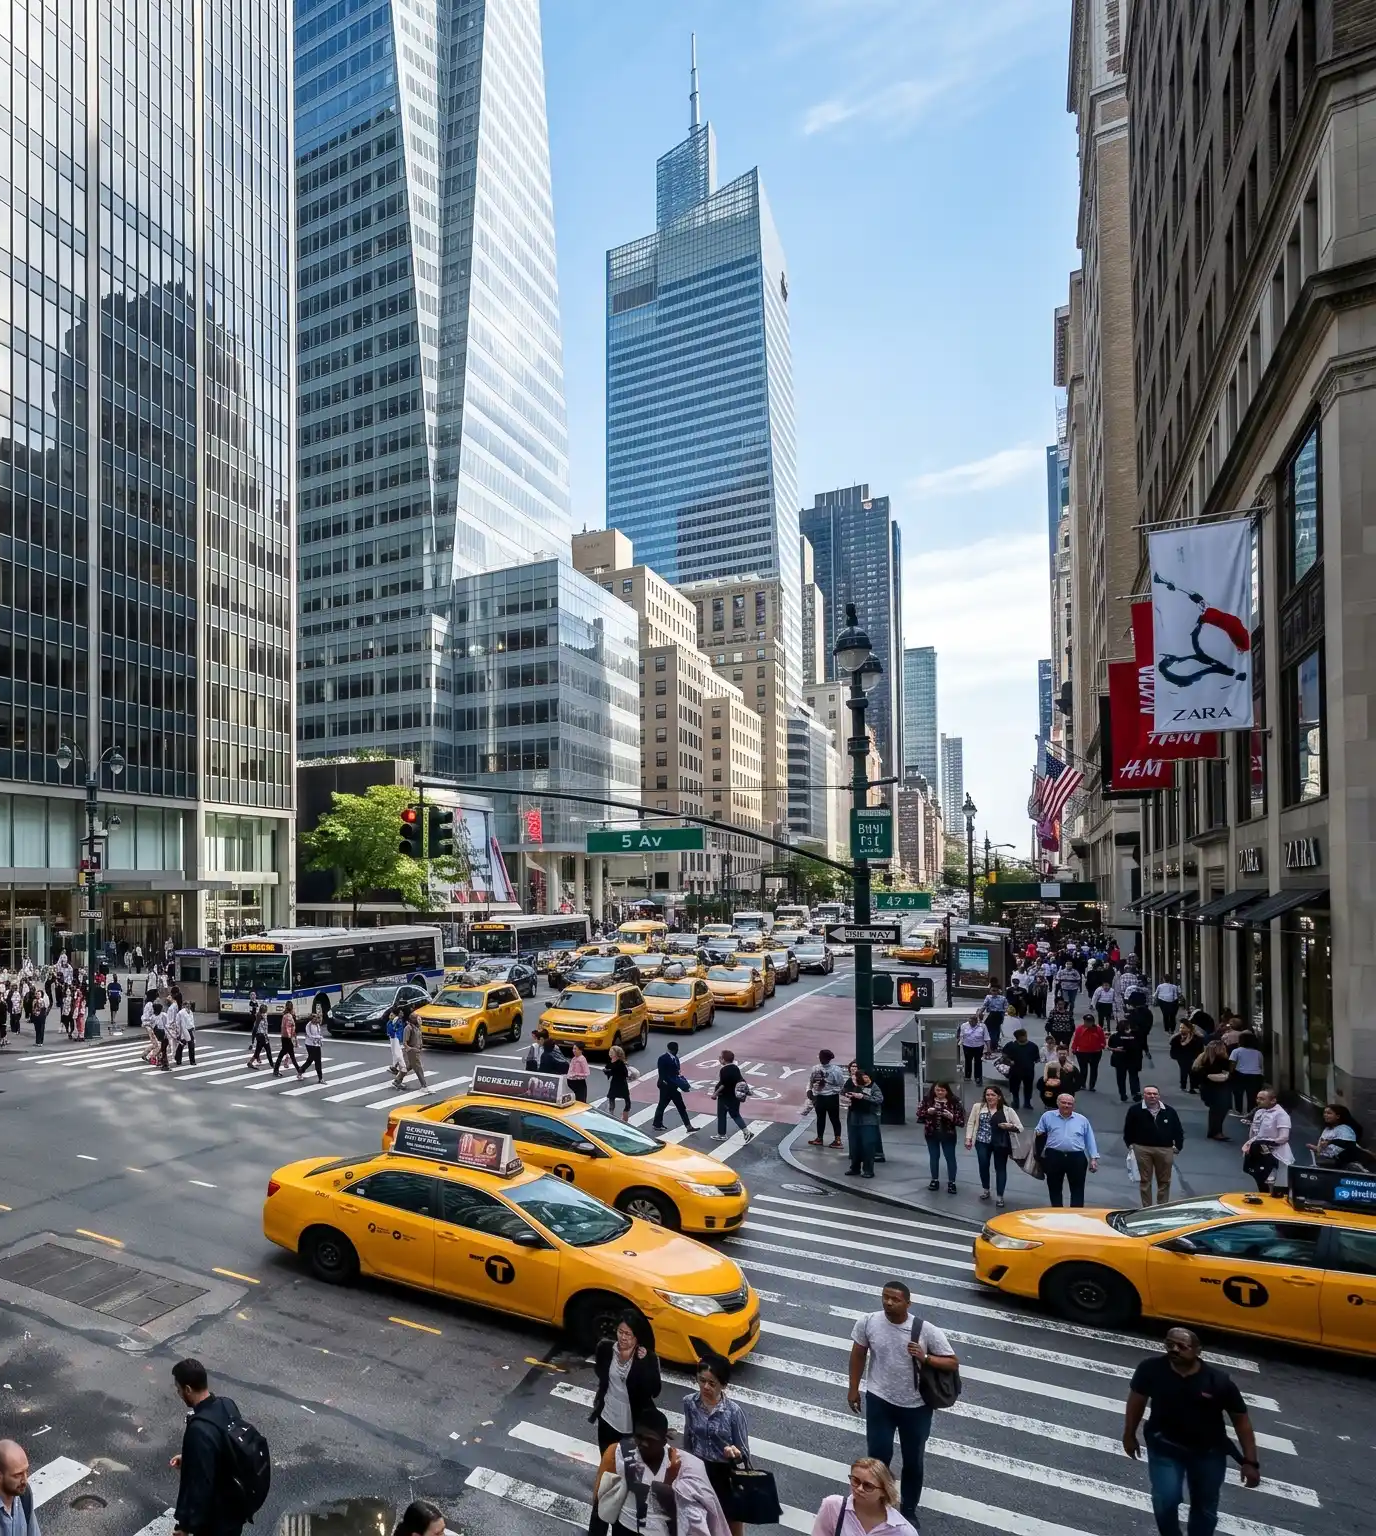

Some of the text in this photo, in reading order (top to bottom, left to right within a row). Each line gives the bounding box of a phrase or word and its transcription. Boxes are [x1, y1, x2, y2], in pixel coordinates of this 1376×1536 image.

[1172, 706, 1233, 721] ZARA
[1119, 758, 1163, 779] H&M
[621, 834, 662, 848] 5 Av
[869, 930, 891, 939] WAY
